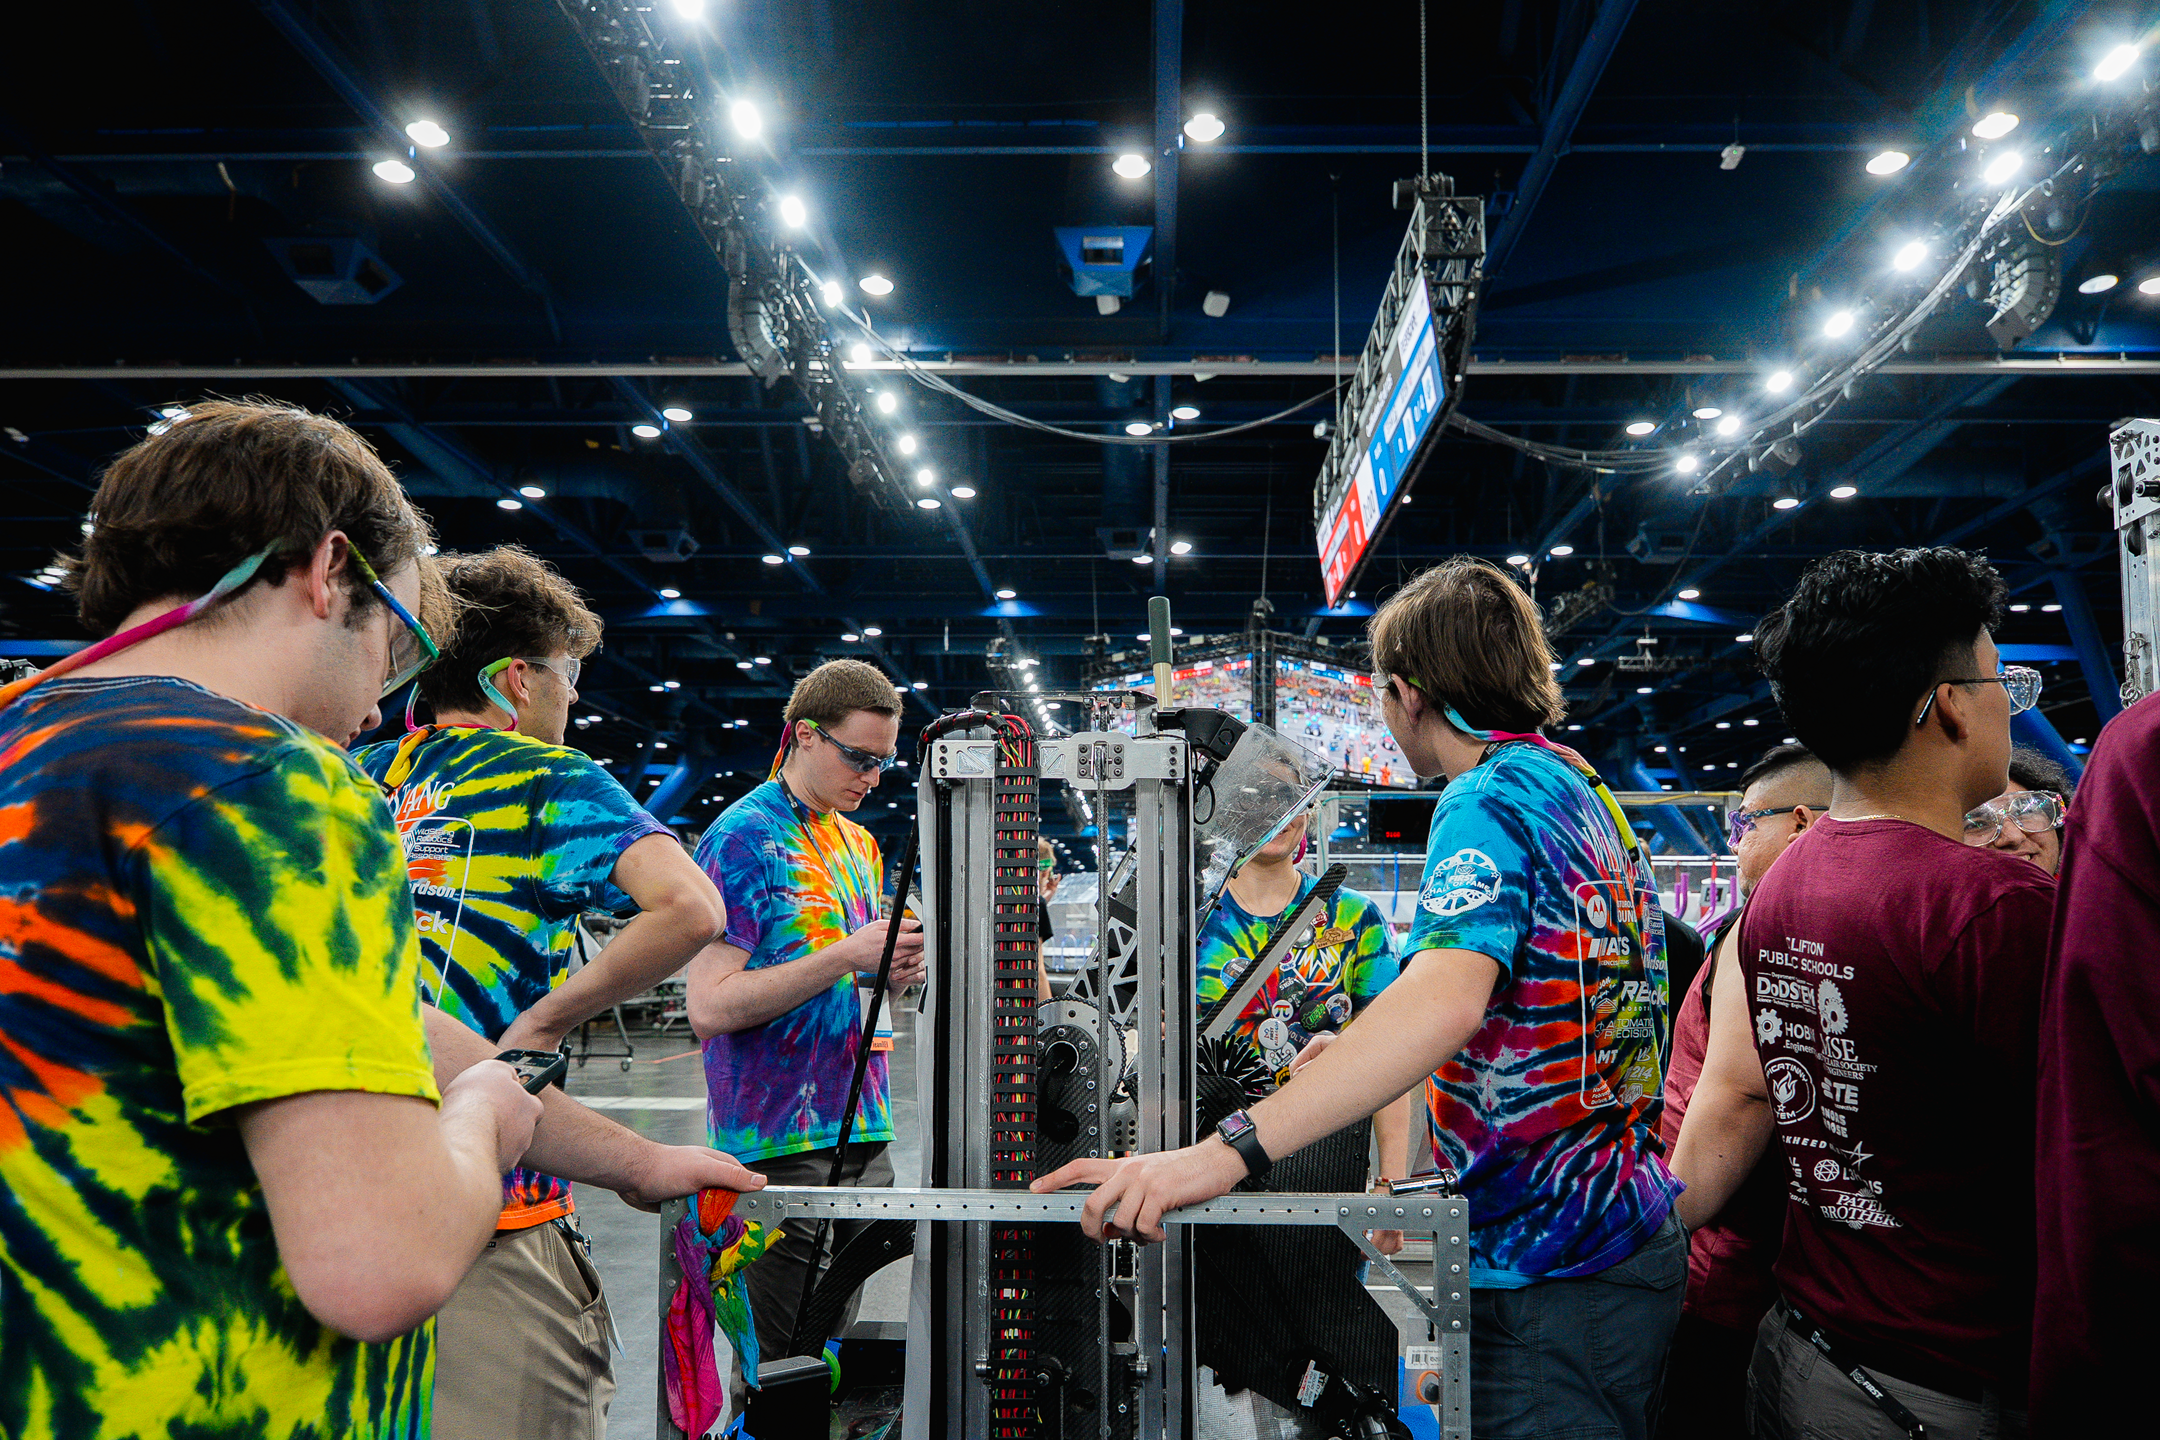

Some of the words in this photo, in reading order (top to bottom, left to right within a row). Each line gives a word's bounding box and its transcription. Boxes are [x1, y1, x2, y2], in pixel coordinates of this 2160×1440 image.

[414, 845, 449, 854] Support
[1430, 884, 1451, 894] HALL
[1466, 880, 1491, 892] FAME
[1800, 957, 1855, 980] SCHOOLS
[1840, 1061, 1878, 1073] SOCIETY
[1833, 1082, 1859, 1106] TE
[1836, 1194, 1886, 1214] PATEL
[1862, 1381, 1884, 1400] FIRST
